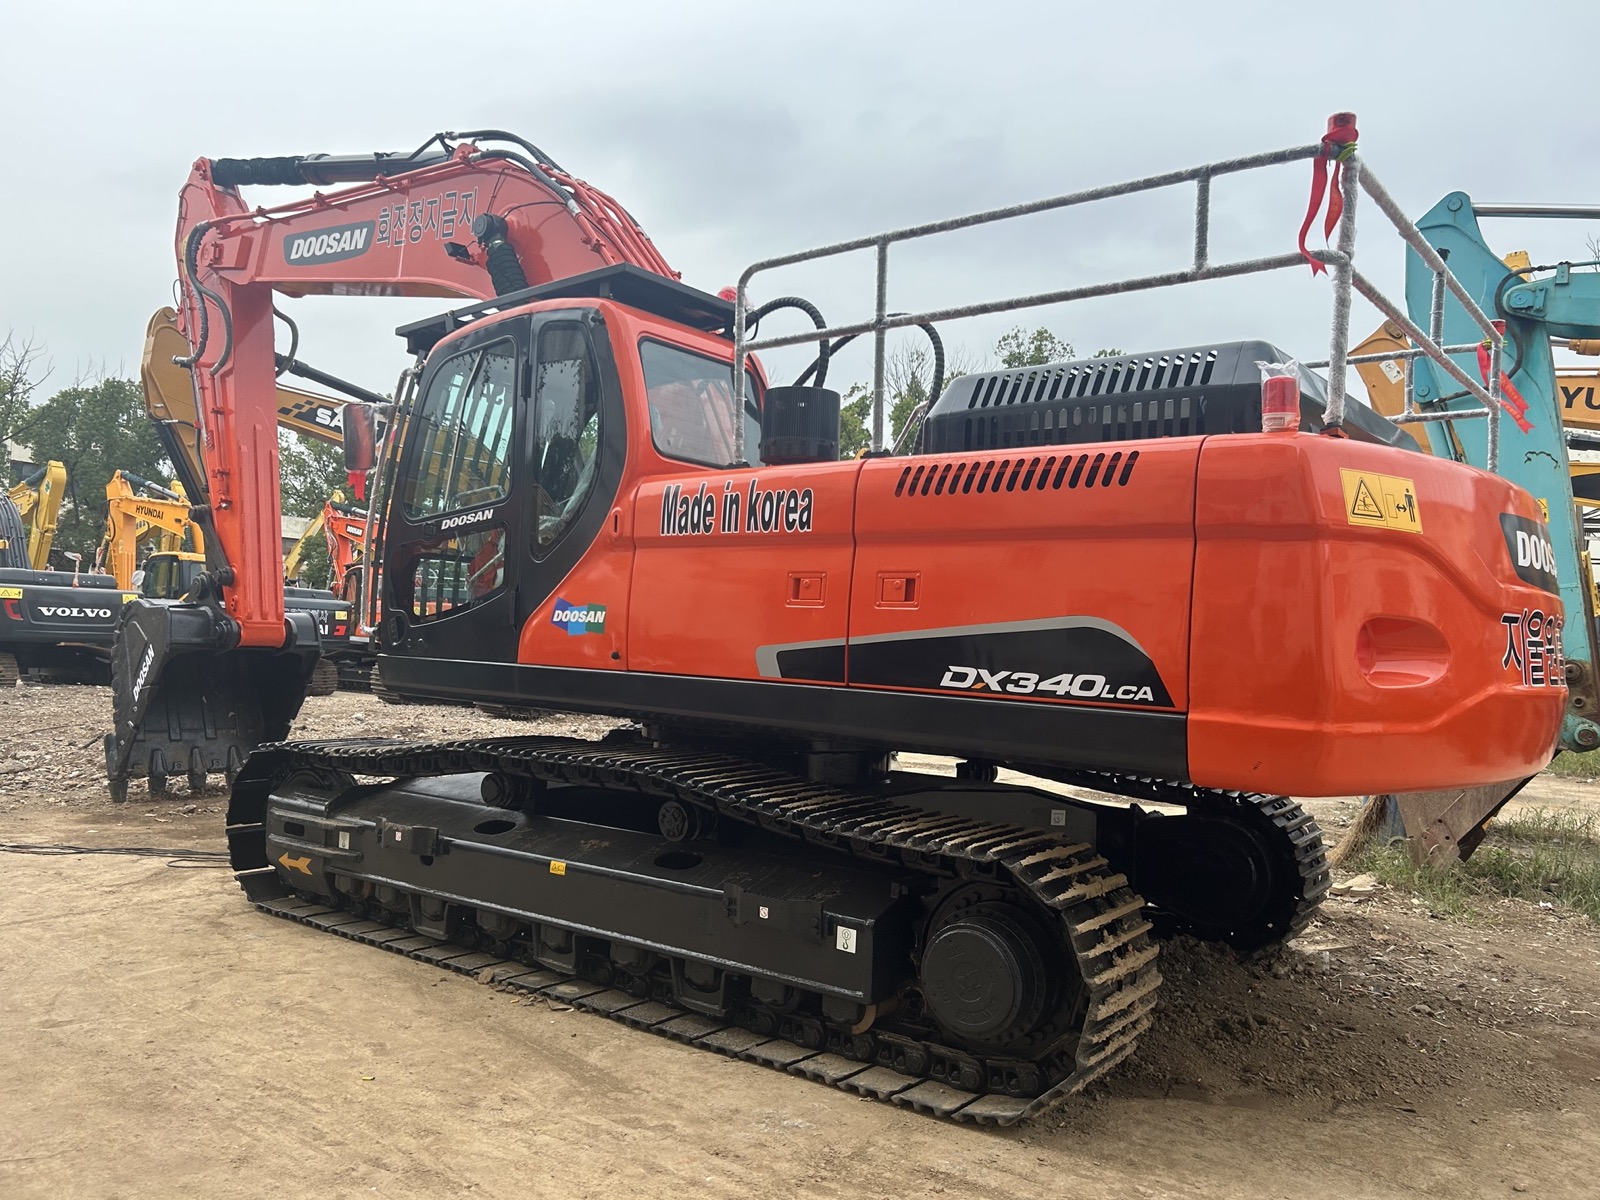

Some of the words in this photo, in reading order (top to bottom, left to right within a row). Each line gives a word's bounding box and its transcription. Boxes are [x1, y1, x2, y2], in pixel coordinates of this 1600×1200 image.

[375, 187, 478, 248] 회전정지금지
[290, 228, 368, 260] DOOSAN
[315, 407, 343, 428] SA
[135, 504, 164, 520] HYUNDAI
[440, 508, 494, 530] DOOSAN
[660, 481, 716, 536] Made
[720, 479, 742, 534] in
[745, 477, 814, 534] korea
[1516, 530, 1558, 578] DOOS
[37, 606, 112, 618] VOLVO
[552, 610, 606, 623] DOOSAN
[132, 643, 155, 702] DOOSAN
